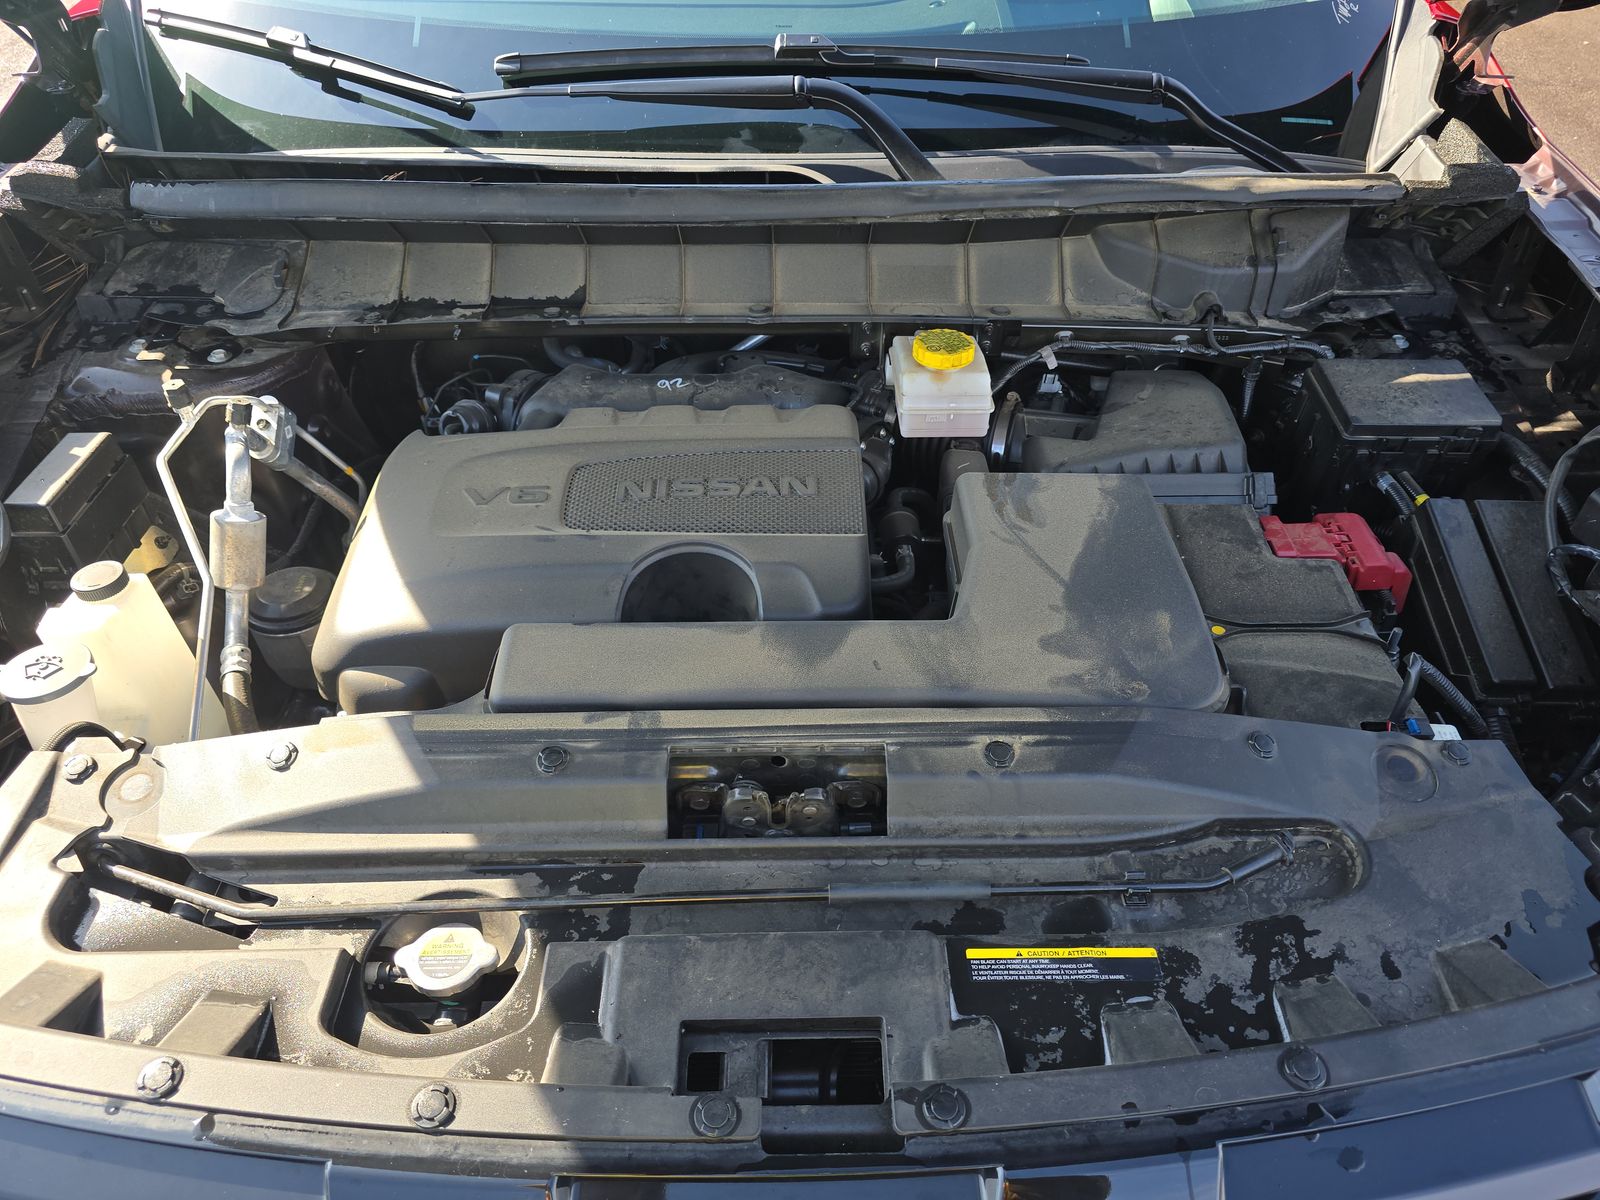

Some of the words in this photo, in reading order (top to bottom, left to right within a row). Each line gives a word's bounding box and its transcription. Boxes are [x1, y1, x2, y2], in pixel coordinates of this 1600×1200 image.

[657, 378, 690, 391] 92
[462, 485, 550, 506] V6
[617, 475, 818, 502] NISSAN
[1067, 949, 1107, 957] ATTENTION
